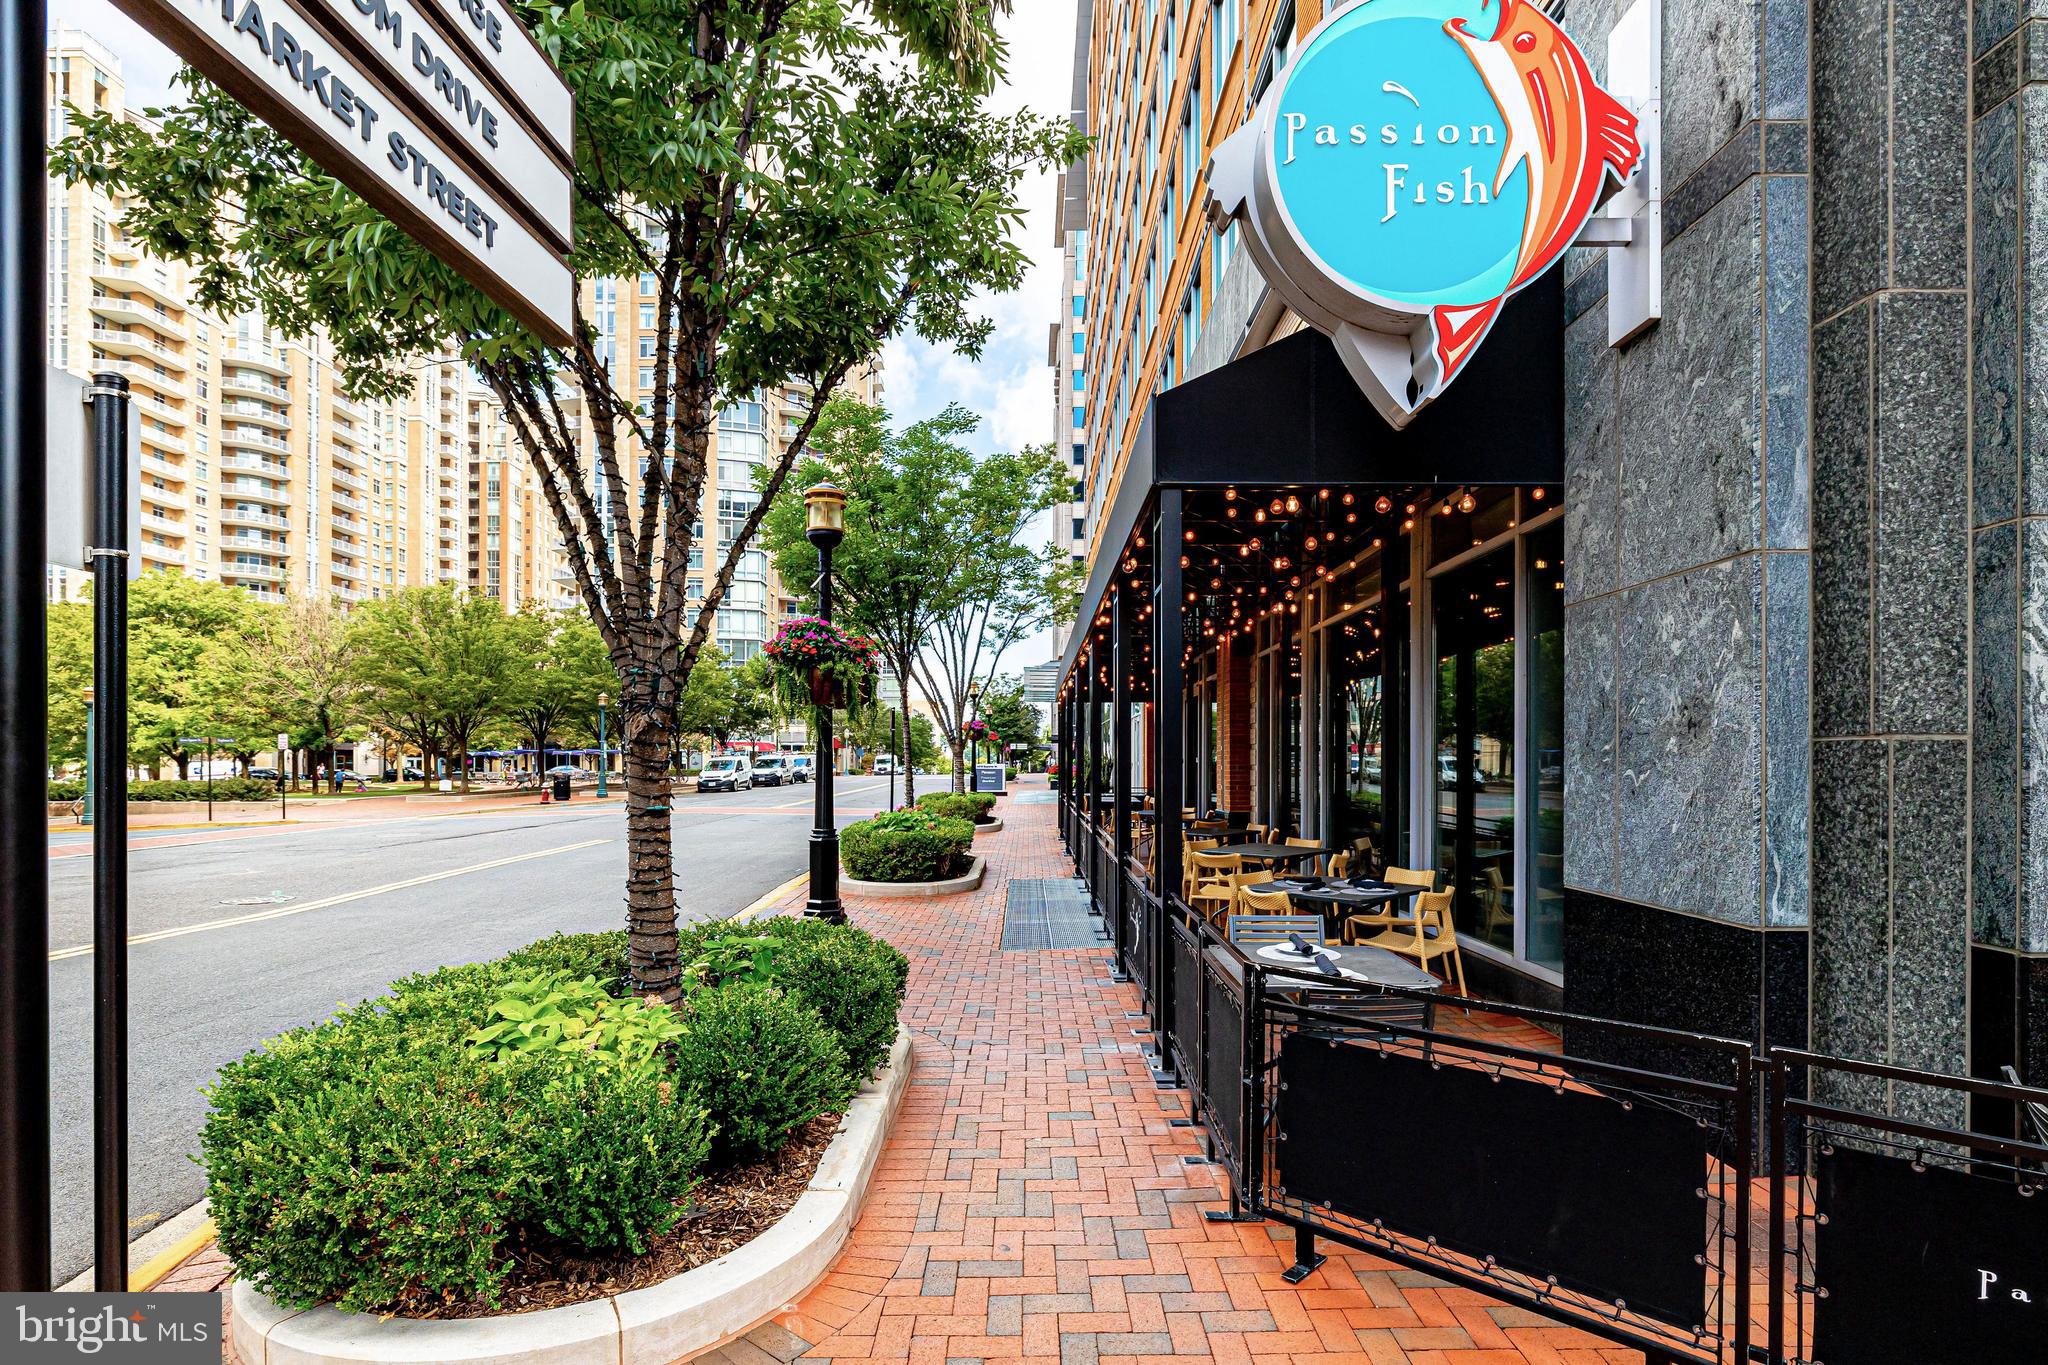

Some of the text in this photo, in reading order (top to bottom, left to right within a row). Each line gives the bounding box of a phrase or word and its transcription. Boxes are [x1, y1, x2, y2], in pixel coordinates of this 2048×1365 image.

[412, 31, 498, 148] DRIVE
[1282, 112, 1497, 165] Passion
[387, 131, 498, 249] STREET
[1380, 163, 1490, 224] Fish
[1977, 1268, 2031, 1303] Pa
